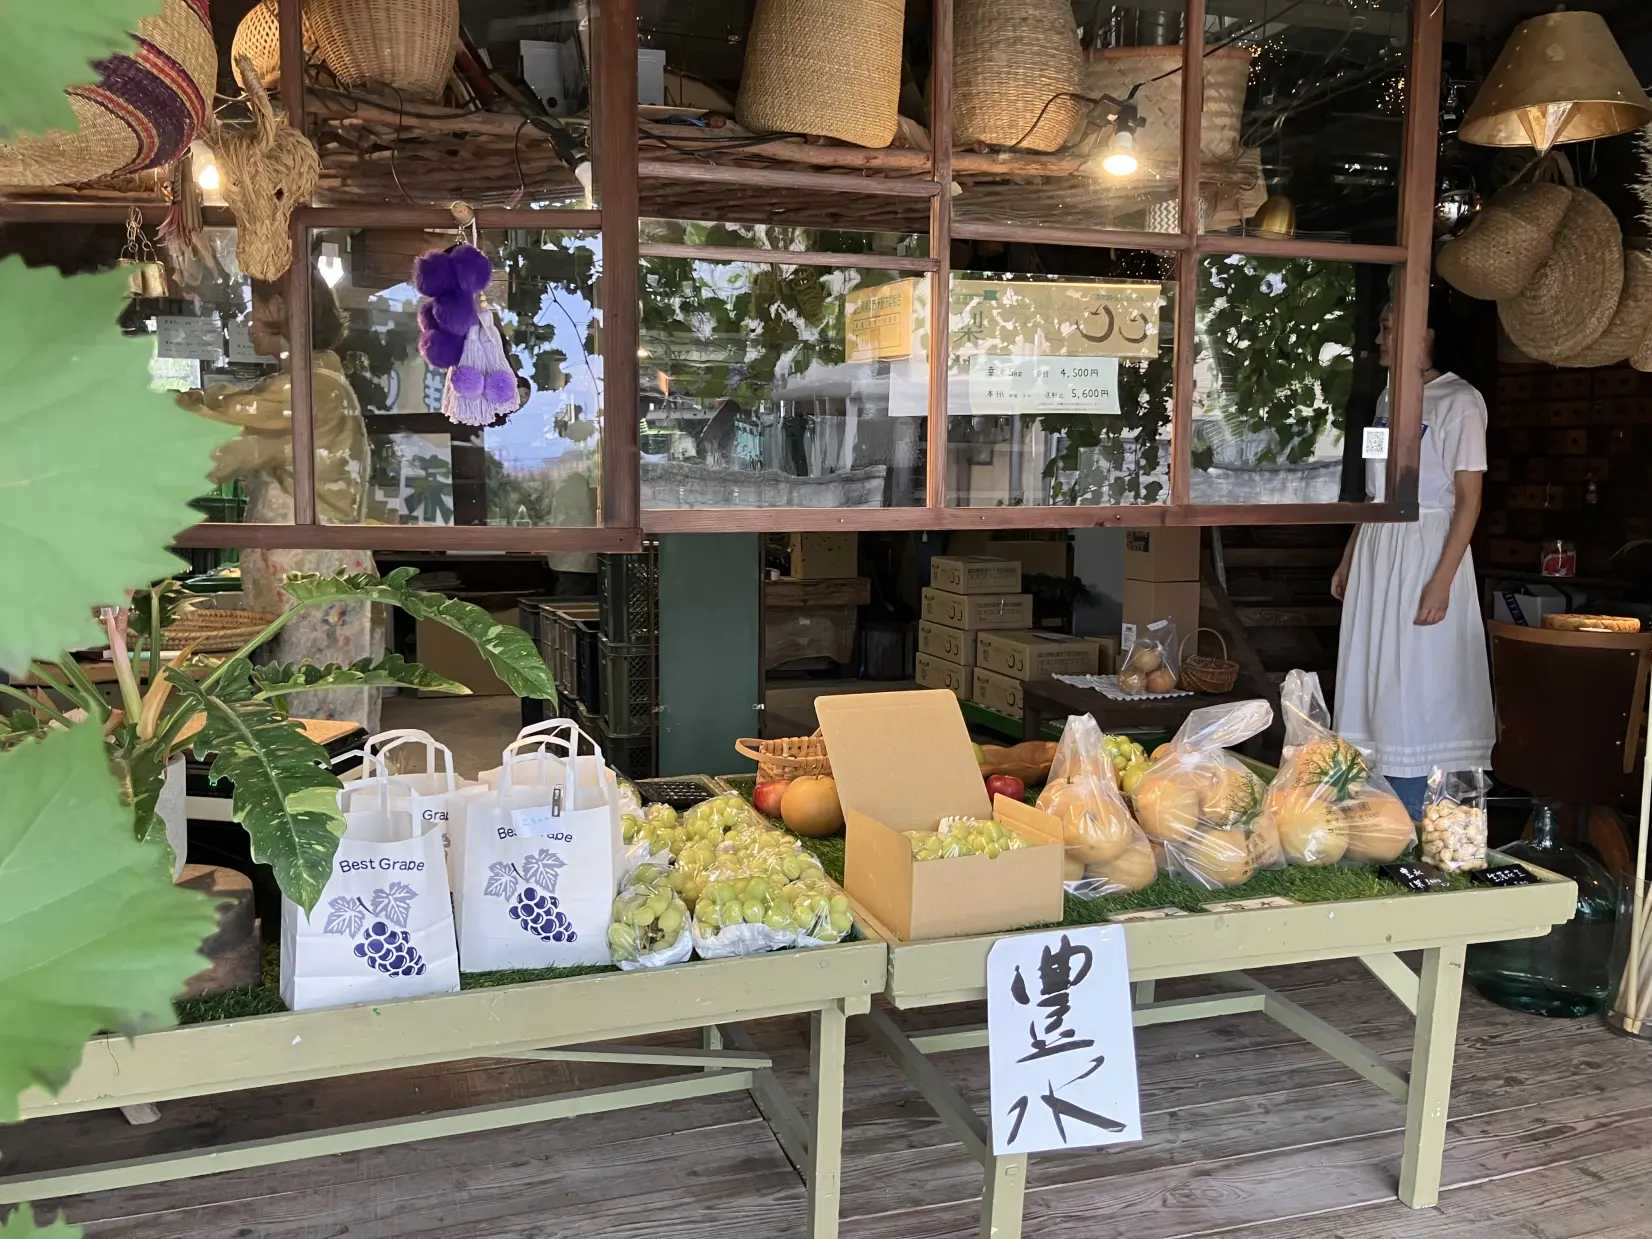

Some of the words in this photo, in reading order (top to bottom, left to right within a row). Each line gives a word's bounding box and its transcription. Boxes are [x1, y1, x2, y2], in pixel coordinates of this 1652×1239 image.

[1060, 368, 1099, 378] 4,500円
[1071, 389, 1109, 399] 5,600円
[422, 810, 449, 821] Gra
[497, 827, 517, 840] Be
[339, 858, 376, 873] Best
[379, 858, 425, 872] Grape
